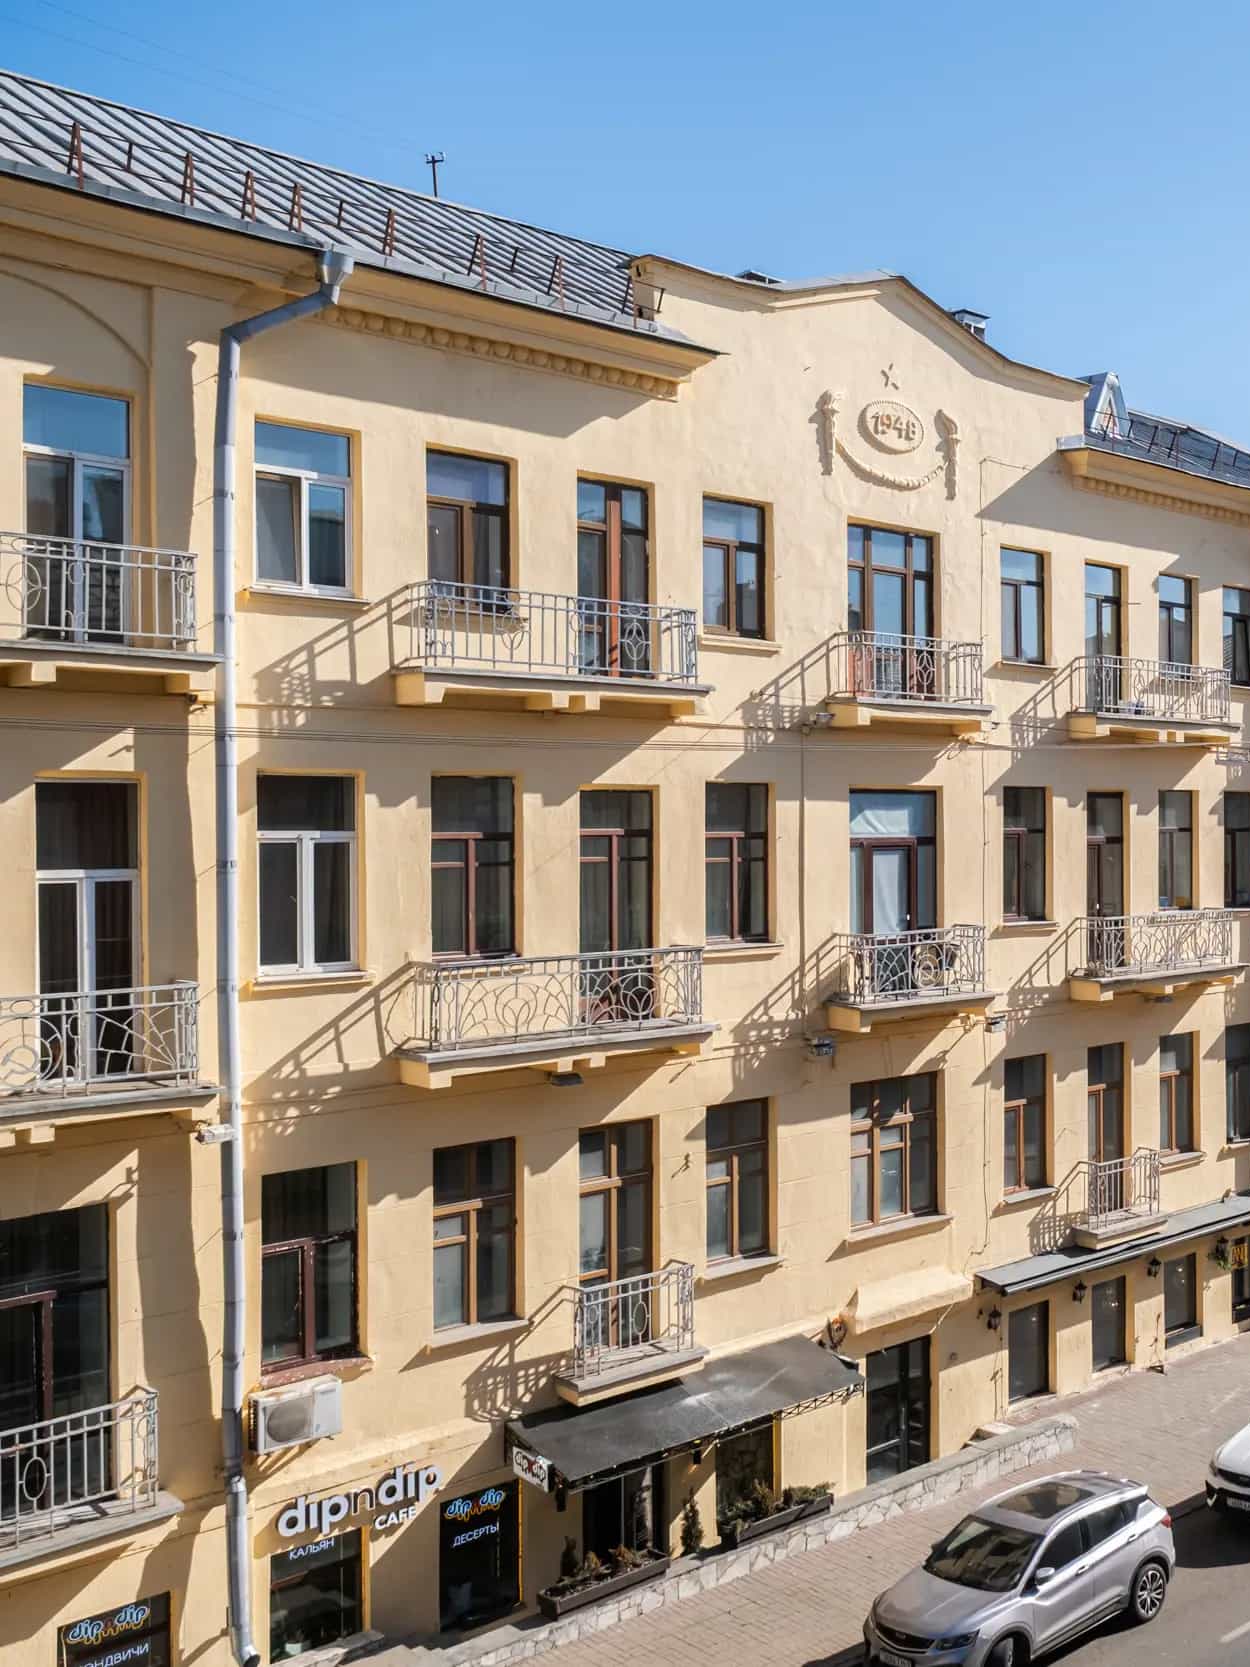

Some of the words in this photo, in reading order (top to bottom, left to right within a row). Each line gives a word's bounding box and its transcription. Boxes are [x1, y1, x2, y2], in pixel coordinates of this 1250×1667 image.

[374, 1503, 417, 1531] CAFE
[452, 1521, 500, 1548] ДЕСЕРТЫ
[288, 1537, 336, 1561] КАЛЬЯН
[79, 1641, 150, 1667] ЭНДВИЧИ
